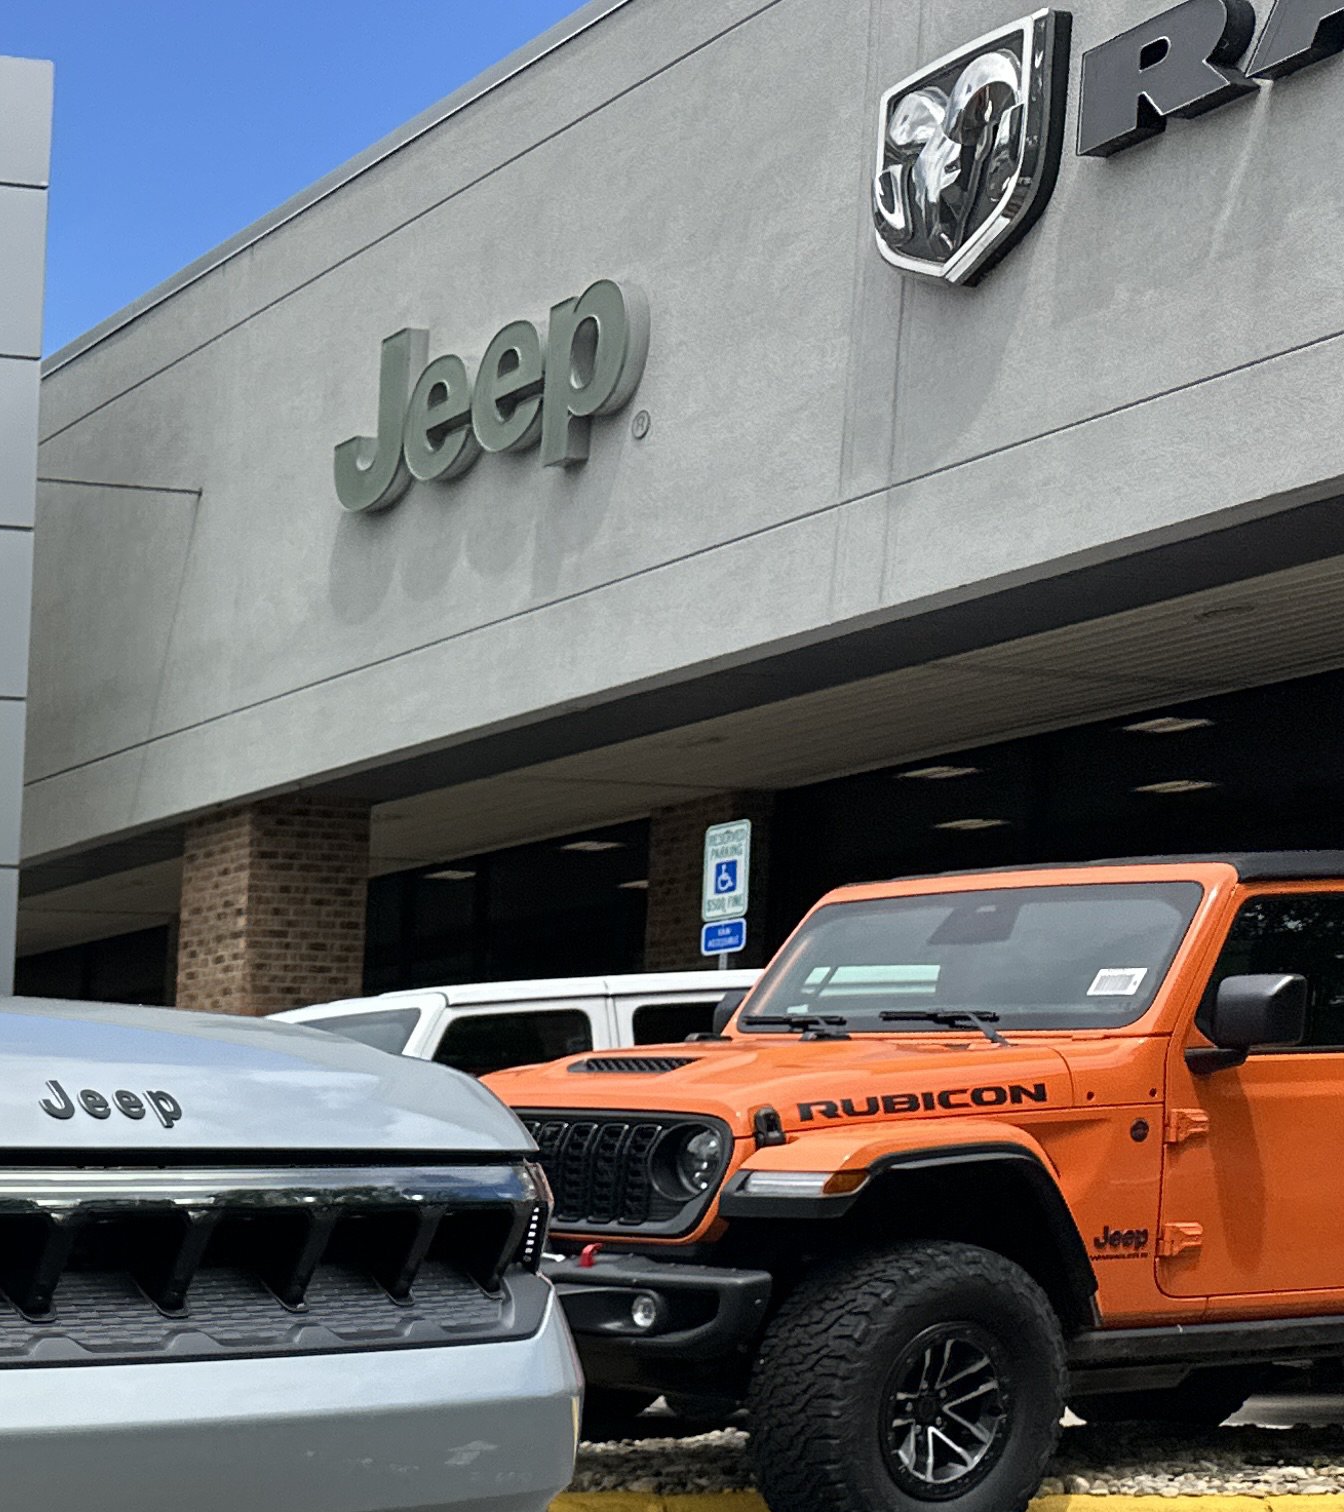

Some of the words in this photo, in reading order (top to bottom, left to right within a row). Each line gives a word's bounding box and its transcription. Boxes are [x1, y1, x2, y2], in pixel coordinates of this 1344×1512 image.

[334, 279, 649, 512] Jeep
[39, 1079, 182, 1129] Jeep
[796, 1083, 1048, 1122] RUBICON
[1093, 1225, 1149, 1250] Jeep
